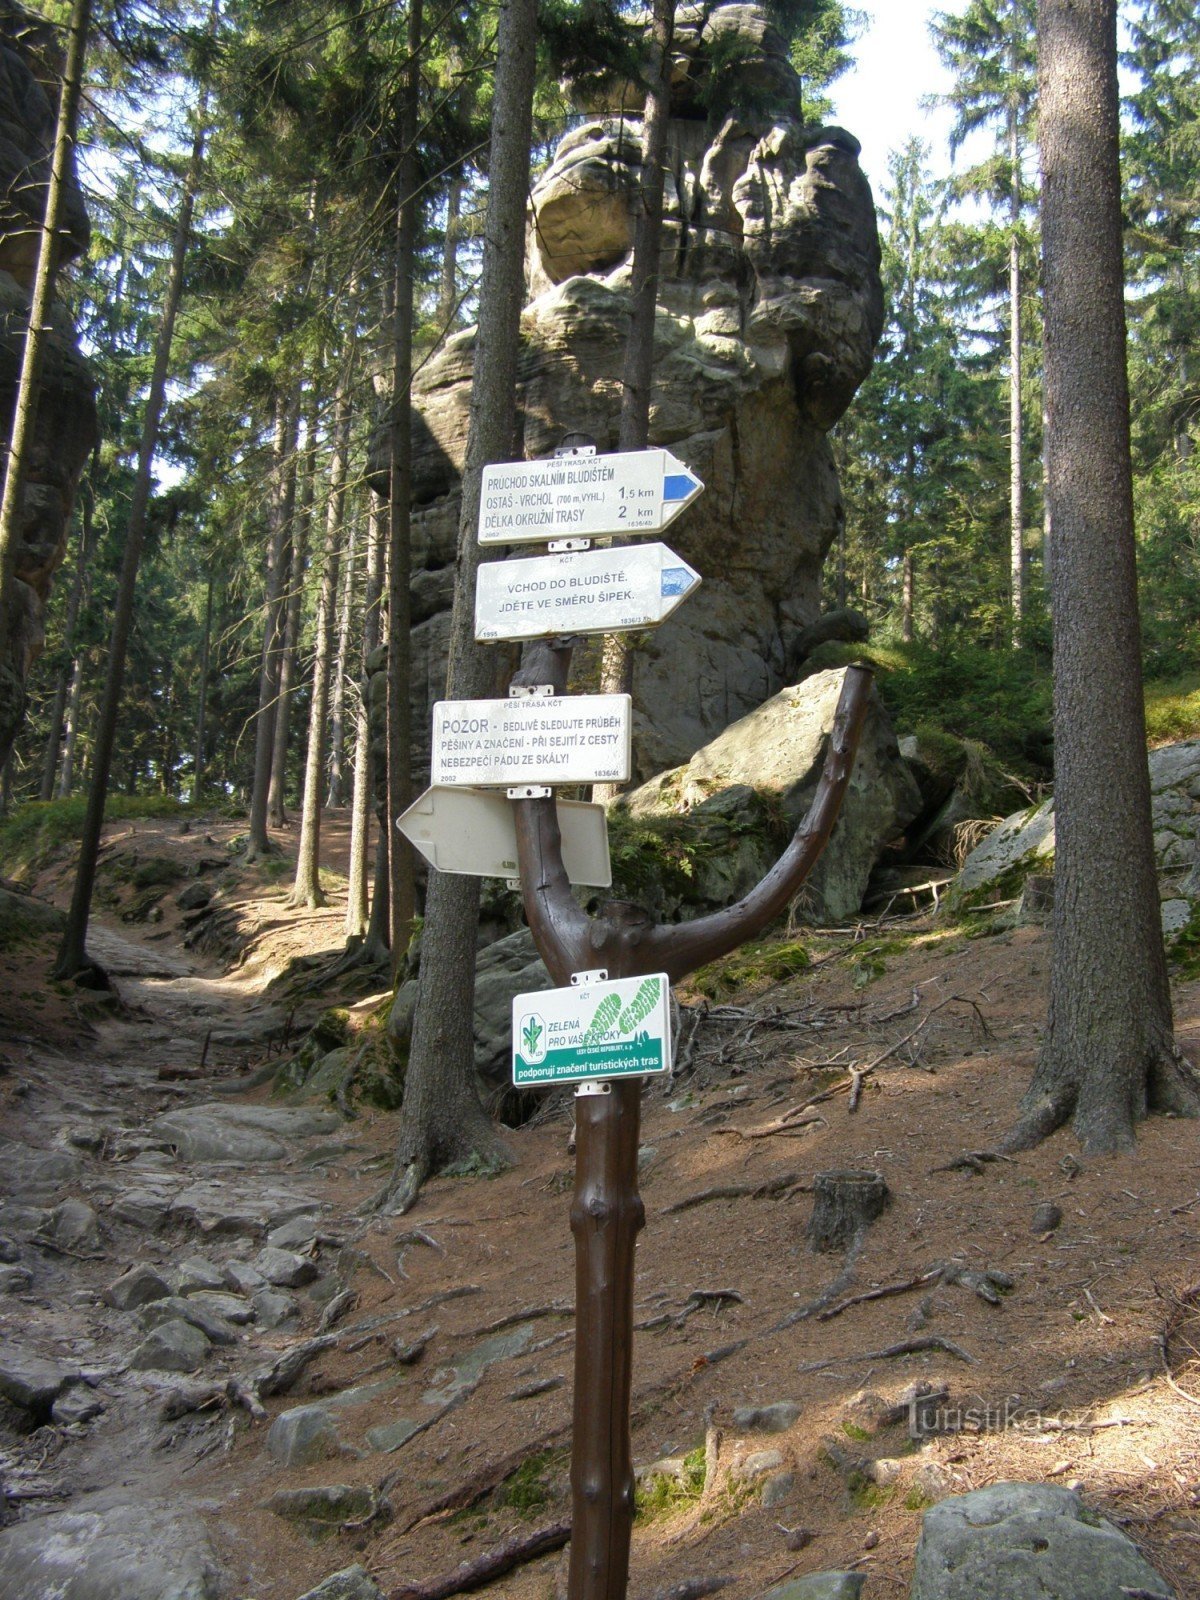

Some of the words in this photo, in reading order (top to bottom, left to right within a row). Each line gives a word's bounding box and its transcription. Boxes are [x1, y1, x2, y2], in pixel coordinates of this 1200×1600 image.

[564, 459, 586, 467] TRASA
[488, 472, 527, 490] PRŮCHOD
[530, 470, 565, 486] SKALNÍM
[567, 466, 614, 483] BLUDIŠTĚM
[487, 494, 513, 509] OSTAŠ
[520, 492, 553, 507] VRCHOL
[618, 487, 635, 500] 1,5
[639, 488, 654, 497] km
[515, 507, 554, 526] OKRUŽNÍ
[556, 509, 584, 522] TRASY
[618, 506, 627, 518] 2
[638, 508, 653, 517] km
[508, 583, 546, 593] VCHOD
[550, 579, 566, 589] DO
[570, 571, 628, 587] BLUDIŠTĚ.
[499, 599, 533, 612] JDĚTE
[537, 599, 551, 609] VE
[555, 593, 595, 607] SMĚRU
[598, 590, 635, 603] ŠIPEK.
[442, 719, 489, 733] POZOR
[503, 719, 539, 732] BEDLIVĚ
[540, 719, 583, 730] SLEDUJTE
[586, 716, 621, 728] PRŮBĚH
[442, 738, 474, 750] PĚŠINY
[476, 740, 483, 749] A
[485, 736, 524, 749] ZNAČENÍ
[532, 736, 547, 746] PŘI
[550, 734, 578, 746] SEJITÍ
[580, 736, 586, 745] Z
[588, 735, 619, 745] CESTY
[441, 754, 492, 768] NEBEZPEČÍ
[495, 754, 520, 766] PÁDU
[522, 755, 534, 764] ZE
[536, 754, 569, 764] SKÁLY!
[548, 1017, 580, 1032] ZELENÁ
[549, 1036, 566, 1047] PRO
[568, 1032, 589, 1044] VAŠE
[591, 1030, 622, 1041] KROKY
[518, 1065, 556, 1079] podporují
[557, 1062, 587, 1073] značení
[589, 1057, 638, 1072] turistických
[641, 1056, 659, 1066] tras
